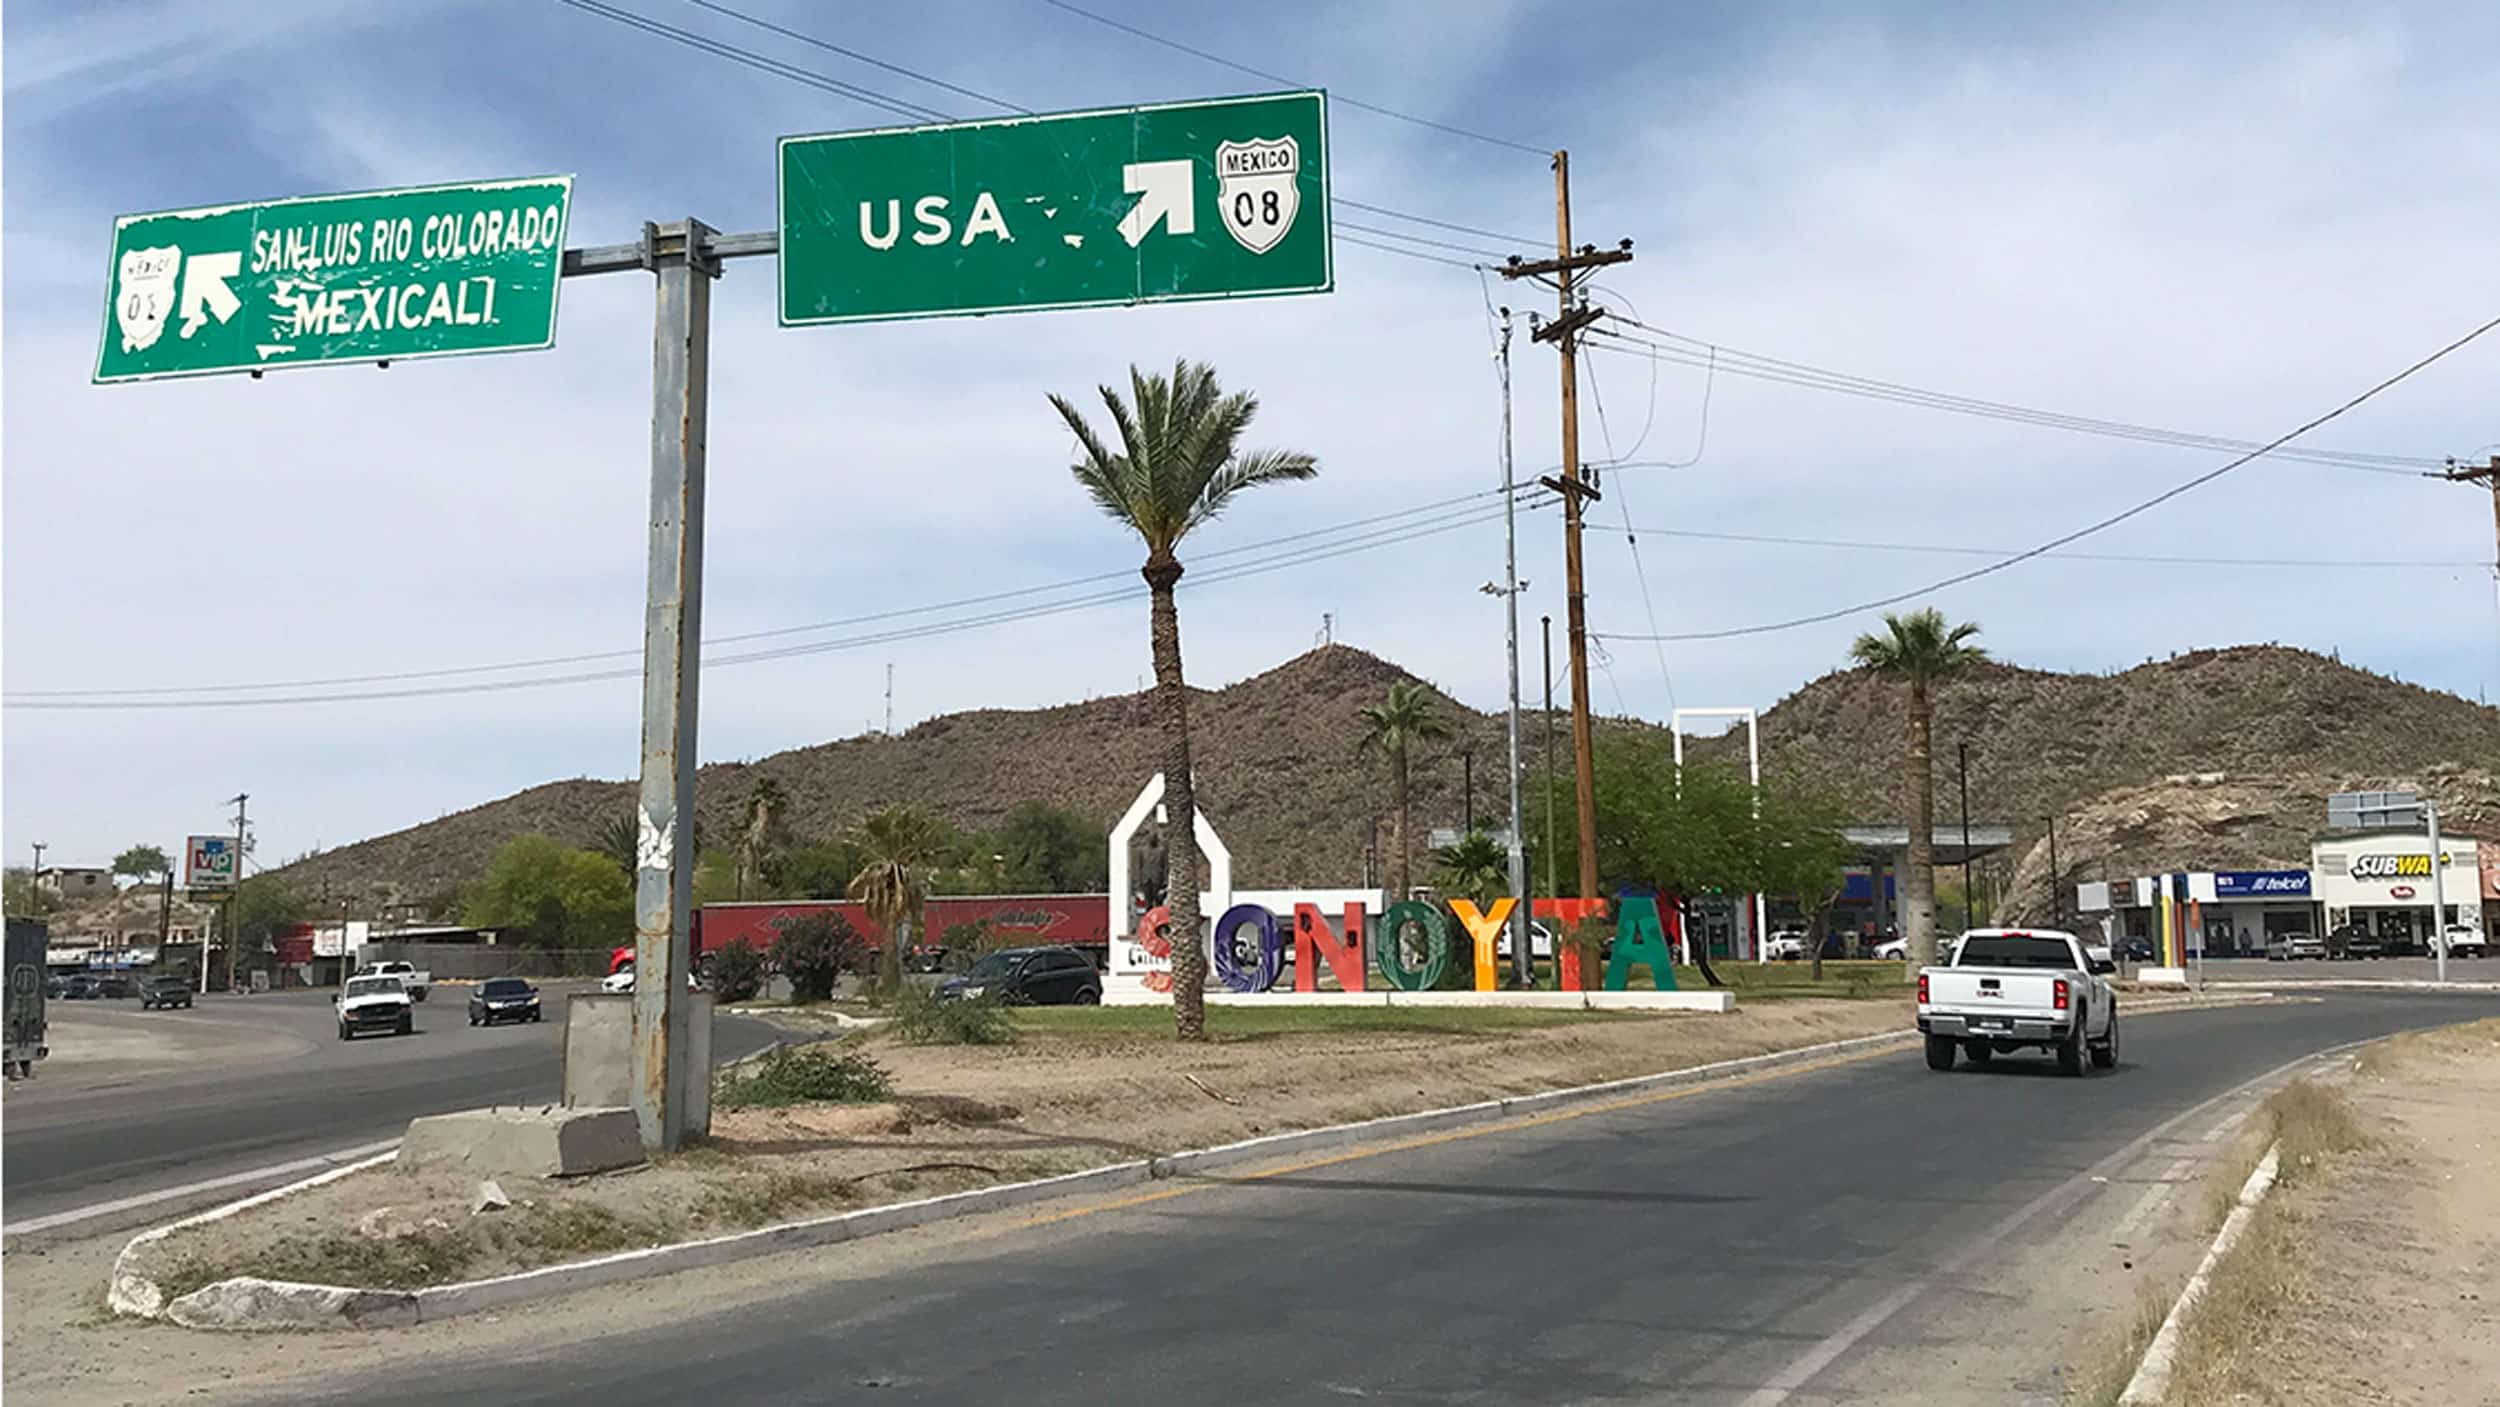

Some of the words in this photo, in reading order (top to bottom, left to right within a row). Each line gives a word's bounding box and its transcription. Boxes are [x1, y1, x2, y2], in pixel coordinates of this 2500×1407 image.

[1226, 149, 1290, 172] MEXICO
[859, 192, 1012, 251] USA
[1235, 190, 1281, 228] 08
[250, 226, 303, 274] SAN
[308, 221, 363, 268] LUIS
[370, 217, 413, 264] RIO
[421, 204, 559, 260] COLORADO
